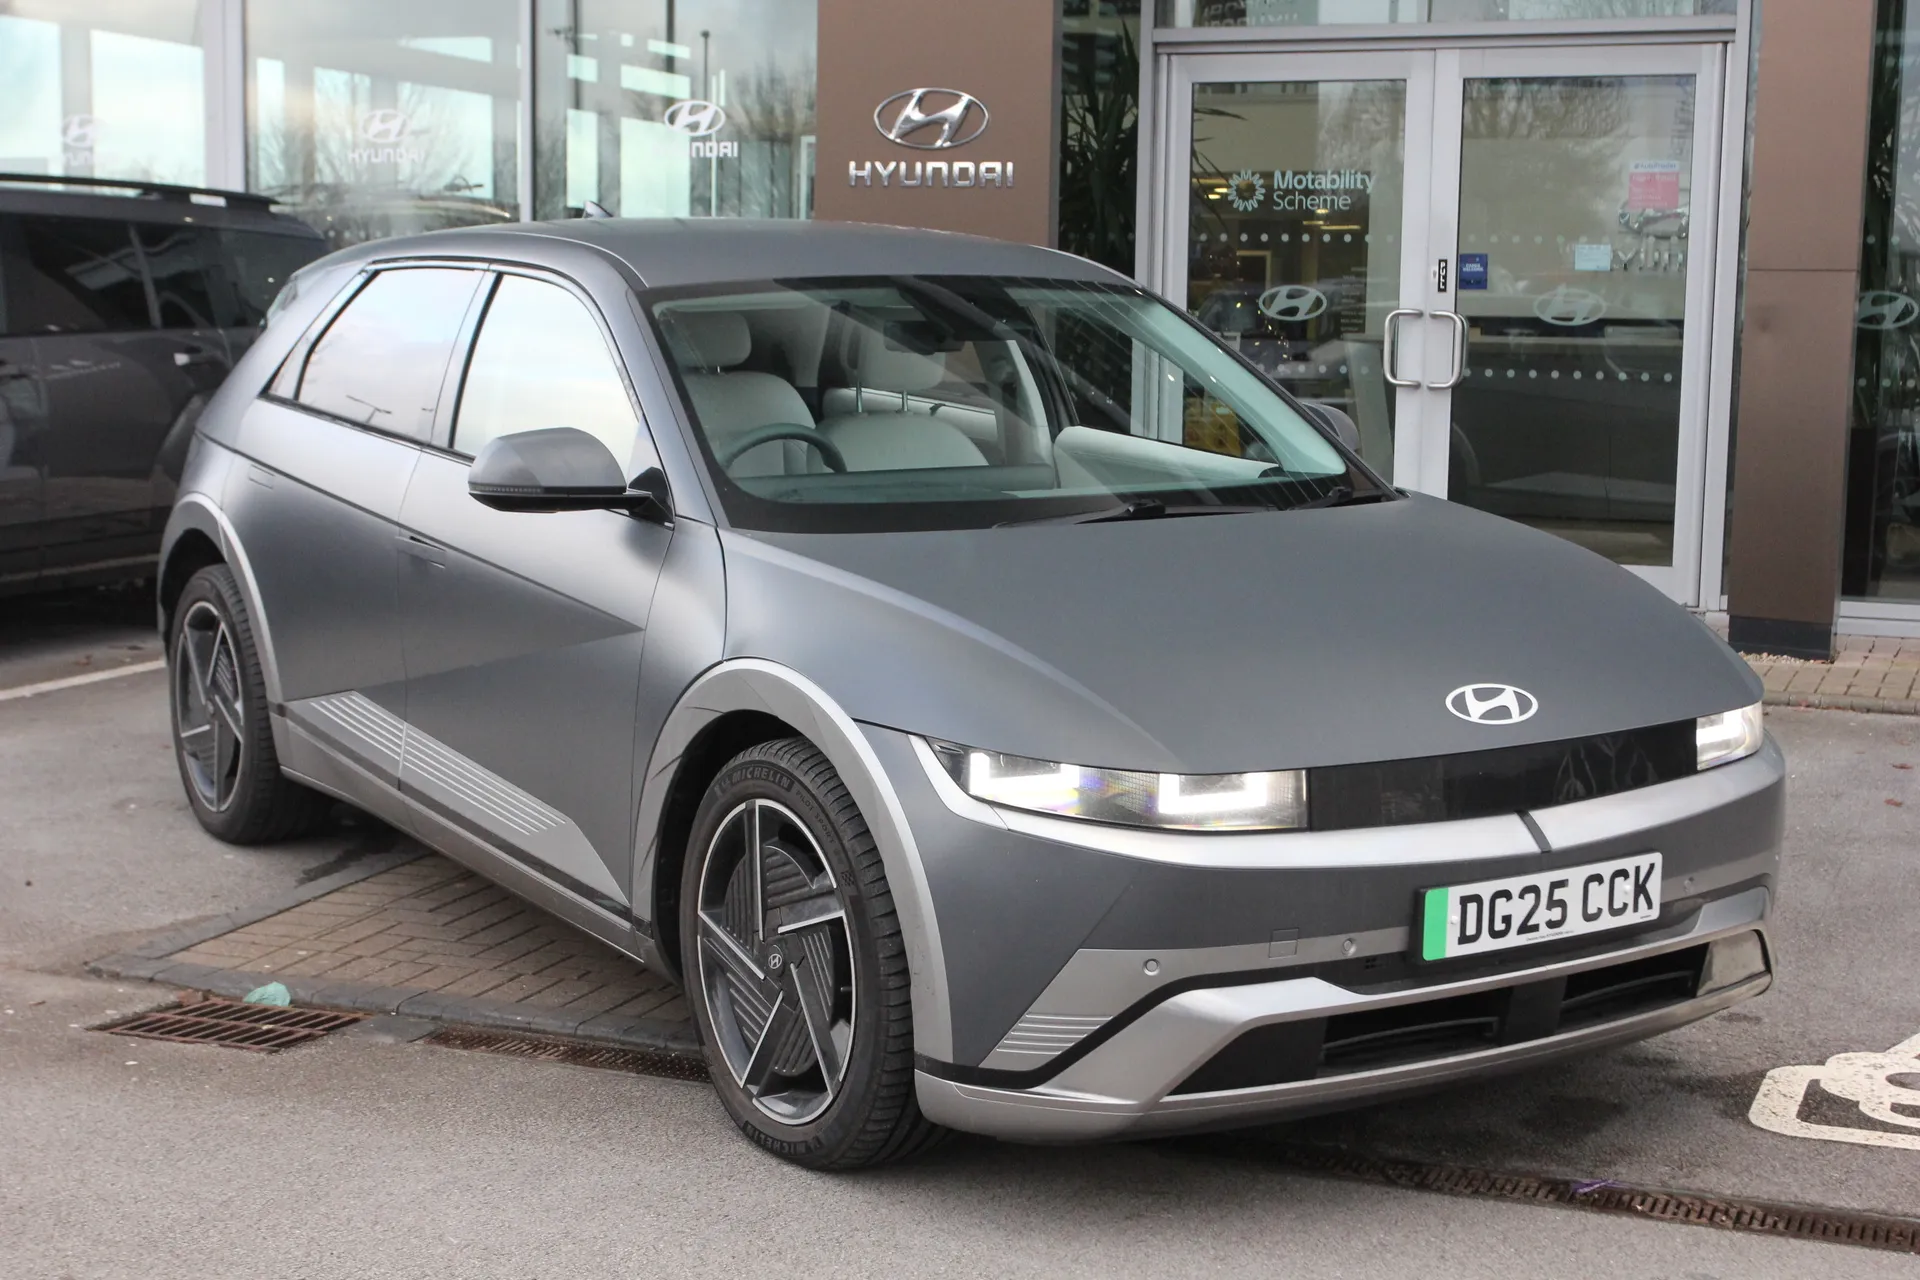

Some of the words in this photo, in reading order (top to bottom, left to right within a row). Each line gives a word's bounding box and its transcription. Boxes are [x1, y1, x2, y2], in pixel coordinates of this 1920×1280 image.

[848, 160, 1014, 187] HYUNDAI
[1273, 169, 1376, 194] Motability
[1273, 191, 1352, 211] Scheme
[732, 766, 791, 789] MICHELIN
[795, 789, 815, 812] PILOT
[1457, 878, 1569, 946] DG25
[1581, 862, 1656, 923] CCK
